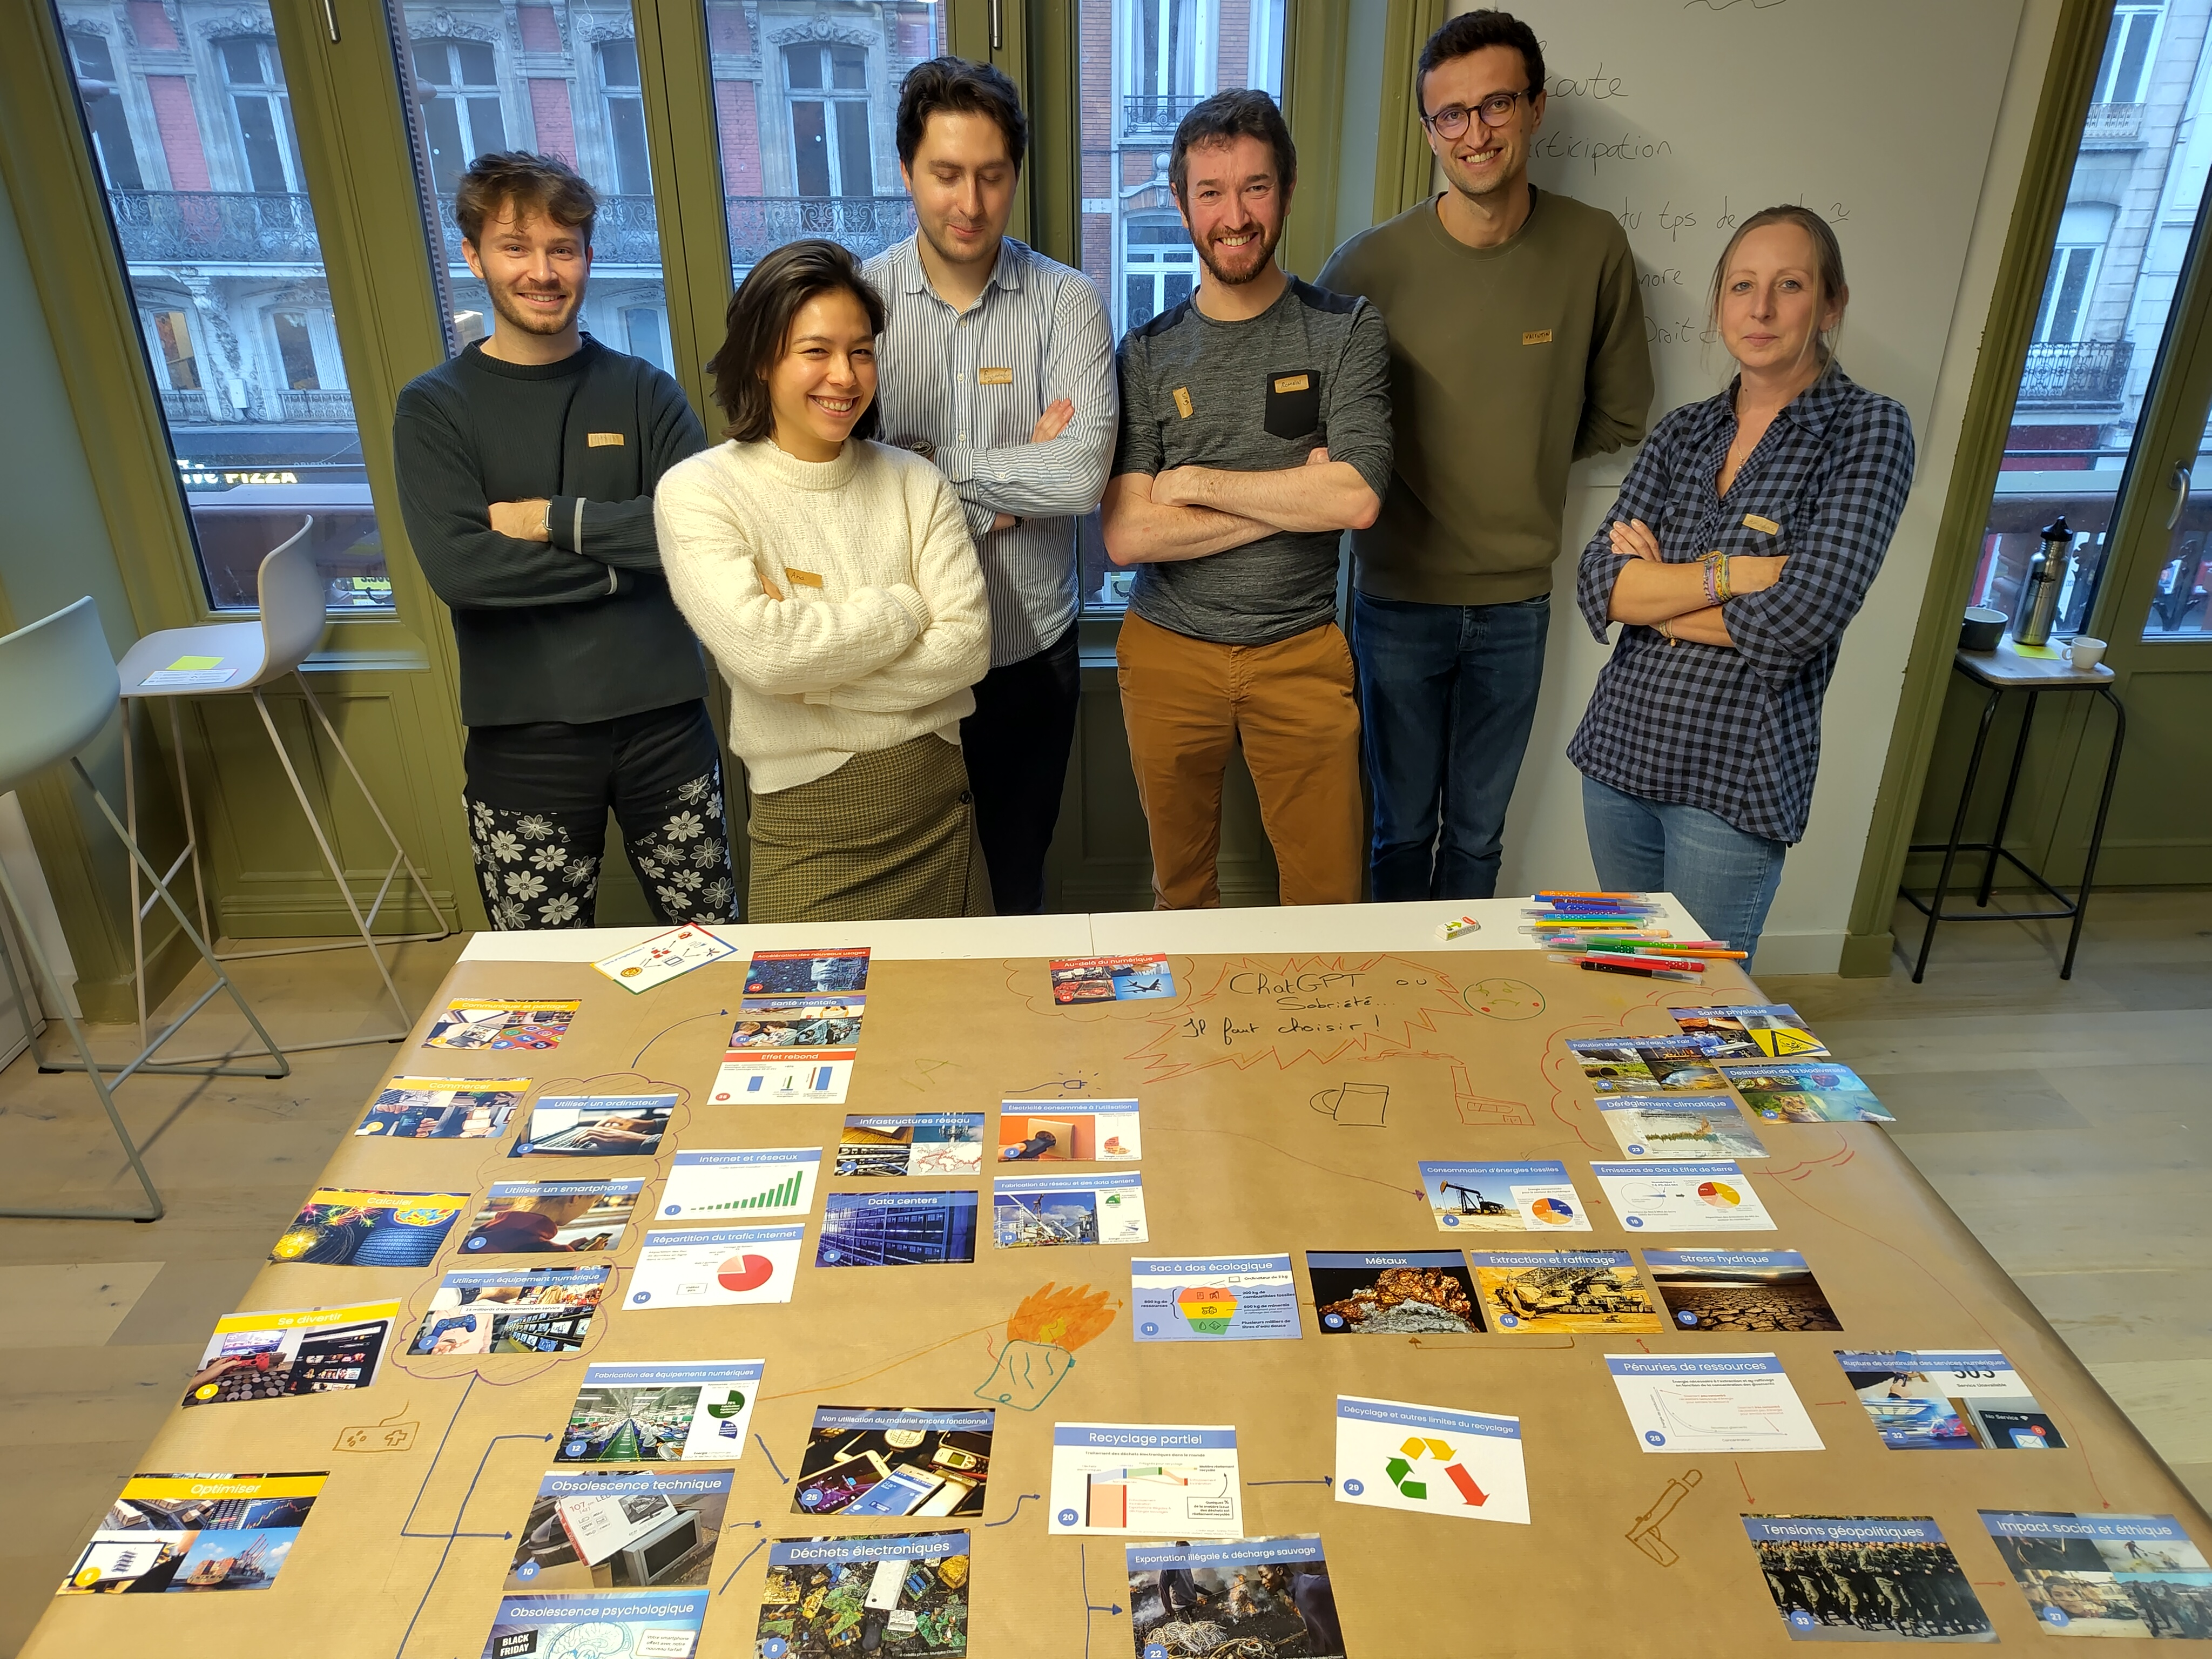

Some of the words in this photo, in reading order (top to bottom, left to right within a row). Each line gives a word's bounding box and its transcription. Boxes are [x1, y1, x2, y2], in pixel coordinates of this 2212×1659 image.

[1546, 63, 1629, 99] coute
[1529, 132, 1671, 176] rticipation
[1659, 201, 1696, 242] tps
[1716, 196, 1737, 229] de
[1282, 380, 1301, 388] ROMAIN
[1230, 973, 1366, 994] ChatGPT
[1182, 1019, 1206, 1037] Il
[1224, 1017, 1259, 1044] faut
[1278, 1017, 1362, 1033] choisir
[1375, 1014, 1380, 1031] !
[1607, 1101, 1672, 1109] Dérèglement
[1674, 1100, 1727, 1108] climatique
[560, 1185, 628, 1193] smartphone
[653, 1236, 709, 1244] Répartition
[757, 1231, 796, 1239] internet
[1563, 1256, 1615, 1265] raffinage
[1718, 1255, 1769, 1264] hydrique
[1150, 1264, 1171, 1272] Sac
[1174, 1264, 1182, 1272] à
[1185, 1263, 1206, 1271] dos
[1209, 1262, 1273, 1271] écologique
[552, 1274, 599, 1282] numérique
[278, 1318, 293, 1326] Se
[296, 1313, 342, 1325] divertir
[1624, 1362, 1677, 1371] Pénuries
[1680, 1363, 1696, 1371] de
[1698, 1362, 1766, 1371] ressources
[656, 1371, 706, 1379] équipements
[1344, 1406, 1388, 1418] Décyclage
[1400, 1413, 1427, 1422] autres
[1429, 1416, 1456, 1426] limites
[1472, 1422, 1514, 1433] recyclage
[1089, 1433, 1157, 1445] Recyclage
[1161, 1434, 1202, 1446] partiel
[191, 1483, 261, 1496] Optimiser
[552, 1481, 649, 1491] Obsolescence
[653, 1479, 721, 1491] technique
[570, 1501, 585, 1512] 107
[1762, 1525, 1827, 1536] Tensions
[1831, 1526, 1924, 1539] géopolitiques
[1997, 1521, 2051, 1534] Impact
[2053, 1523, 2096, 1534] social
[2099, 1526, 2114, 1534] et
[2116, 1525, 2172, 1537] éthique
[790, 1547, 848, 1559] Déchets
[853, 1542, 949, 1556] électroniques
[1135, 1554, 1186, 1564] Exportation
[1188, 1552, 1219, 1562] illégale
[1231, 1549, 1274, 1560] décharge
[1277, 1547, 1316, 1557] sauvage
[510, 1607, 599, 1617] Obsolescence
[602, 1604, 694, 1618] psychologique
[503, 1634, 529, 1646] BLACK
[500, 1644, 528, 1656] FRIDAY
